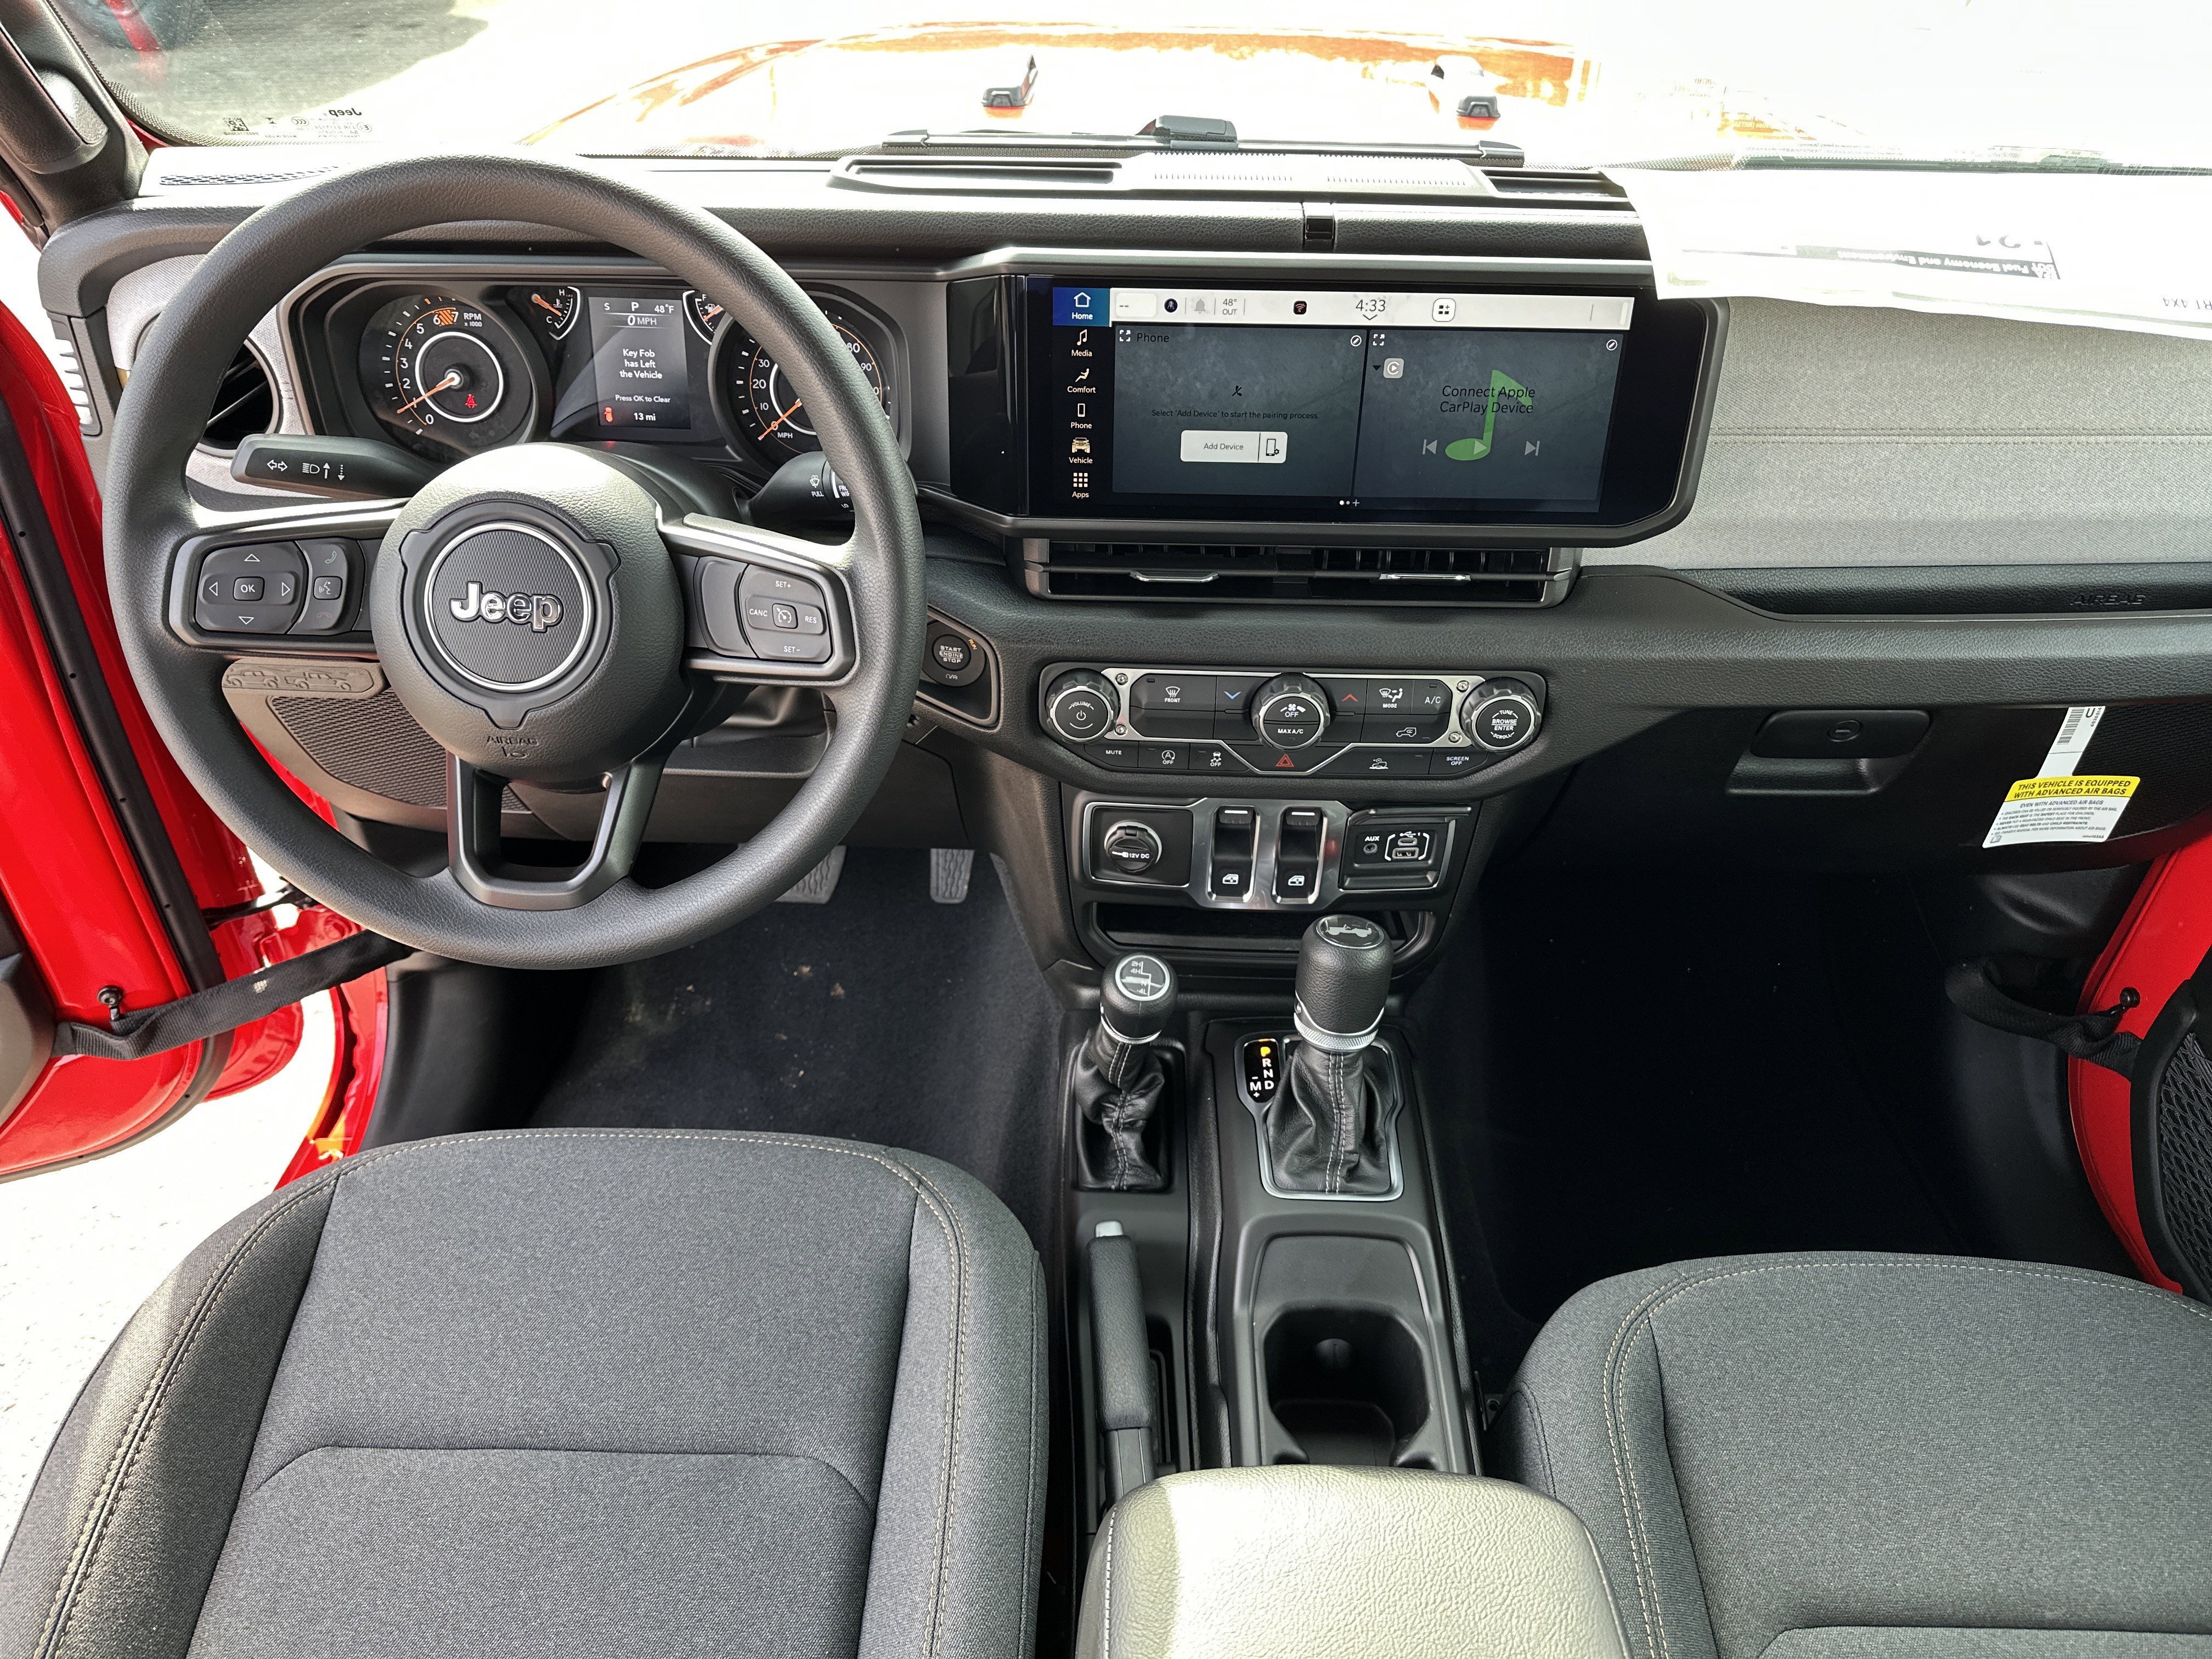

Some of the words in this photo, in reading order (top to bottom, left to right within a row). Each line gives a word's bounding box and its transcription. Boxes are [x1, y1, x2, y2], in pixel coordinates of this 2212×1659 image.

[1920, 257, 1941, 266] and
[1944, 257, 2001, 272] Economy
[2002, 264, 2029, 274] Fuel
[604, 302, 610, 311] S
[631, 302, 639, 311] P
[654, 303, 674, 313] 48°F
[1355, 300, 1386, 312] 4:33
[2163, 297, 2188, 308] 4X4
[433, 314, 441, 325] 6
[452, 311, 459, 322] 7
[628, 315, 635, 325] 0
[637, 317, 657, 325] MPH
[416, 323, 425, 334] 5
[1136, 332, 1170, 342] Phone
[404, 338, 413, 349] 4
[623, 349, 639, 358] Key
[640, 349, 655, 357] Fob
[400, 358, 409, 369] 3
[640, 360, 656, 368] Left
[758, 359, 770, 368] 30
[861, 363, 872, 371] 90
[634, 371, 663, 379] Vehicle
[402, 378, 411, 389] 2
[752, 379, 766, 389] 20
[1442, 385, 1496, 397] Connect
[1498, 386, 1536, 400] Apple
[1440, 401, 1488, 415] CarPlay
[1492, 402, 1533, 414] Device
[426, 414, 434, 425] 0
[1262, 412, 1288, 421] pairing
[1070, 421, 1092, 430] Phone
[1071, 491, 1089, 499] Apps
[240, 584, 255, 593] OK
[450, 582, 564, 633] Jeep
[749, 608, 768, 617] CANC
[939, 651, 963, 659] ENGINE
[2039, 780, 2073, 788] VEHICLE
[2014, 791, 2034, 799] WITH
[1260, 1046, 1271, 1057] P
[1262, 1058, 1272, 1068] R
[1263, 1068, 1274, 1079] N
[1250, 1081, 1262, 1091] M
[1264, 1080, 1274, 1090] D
